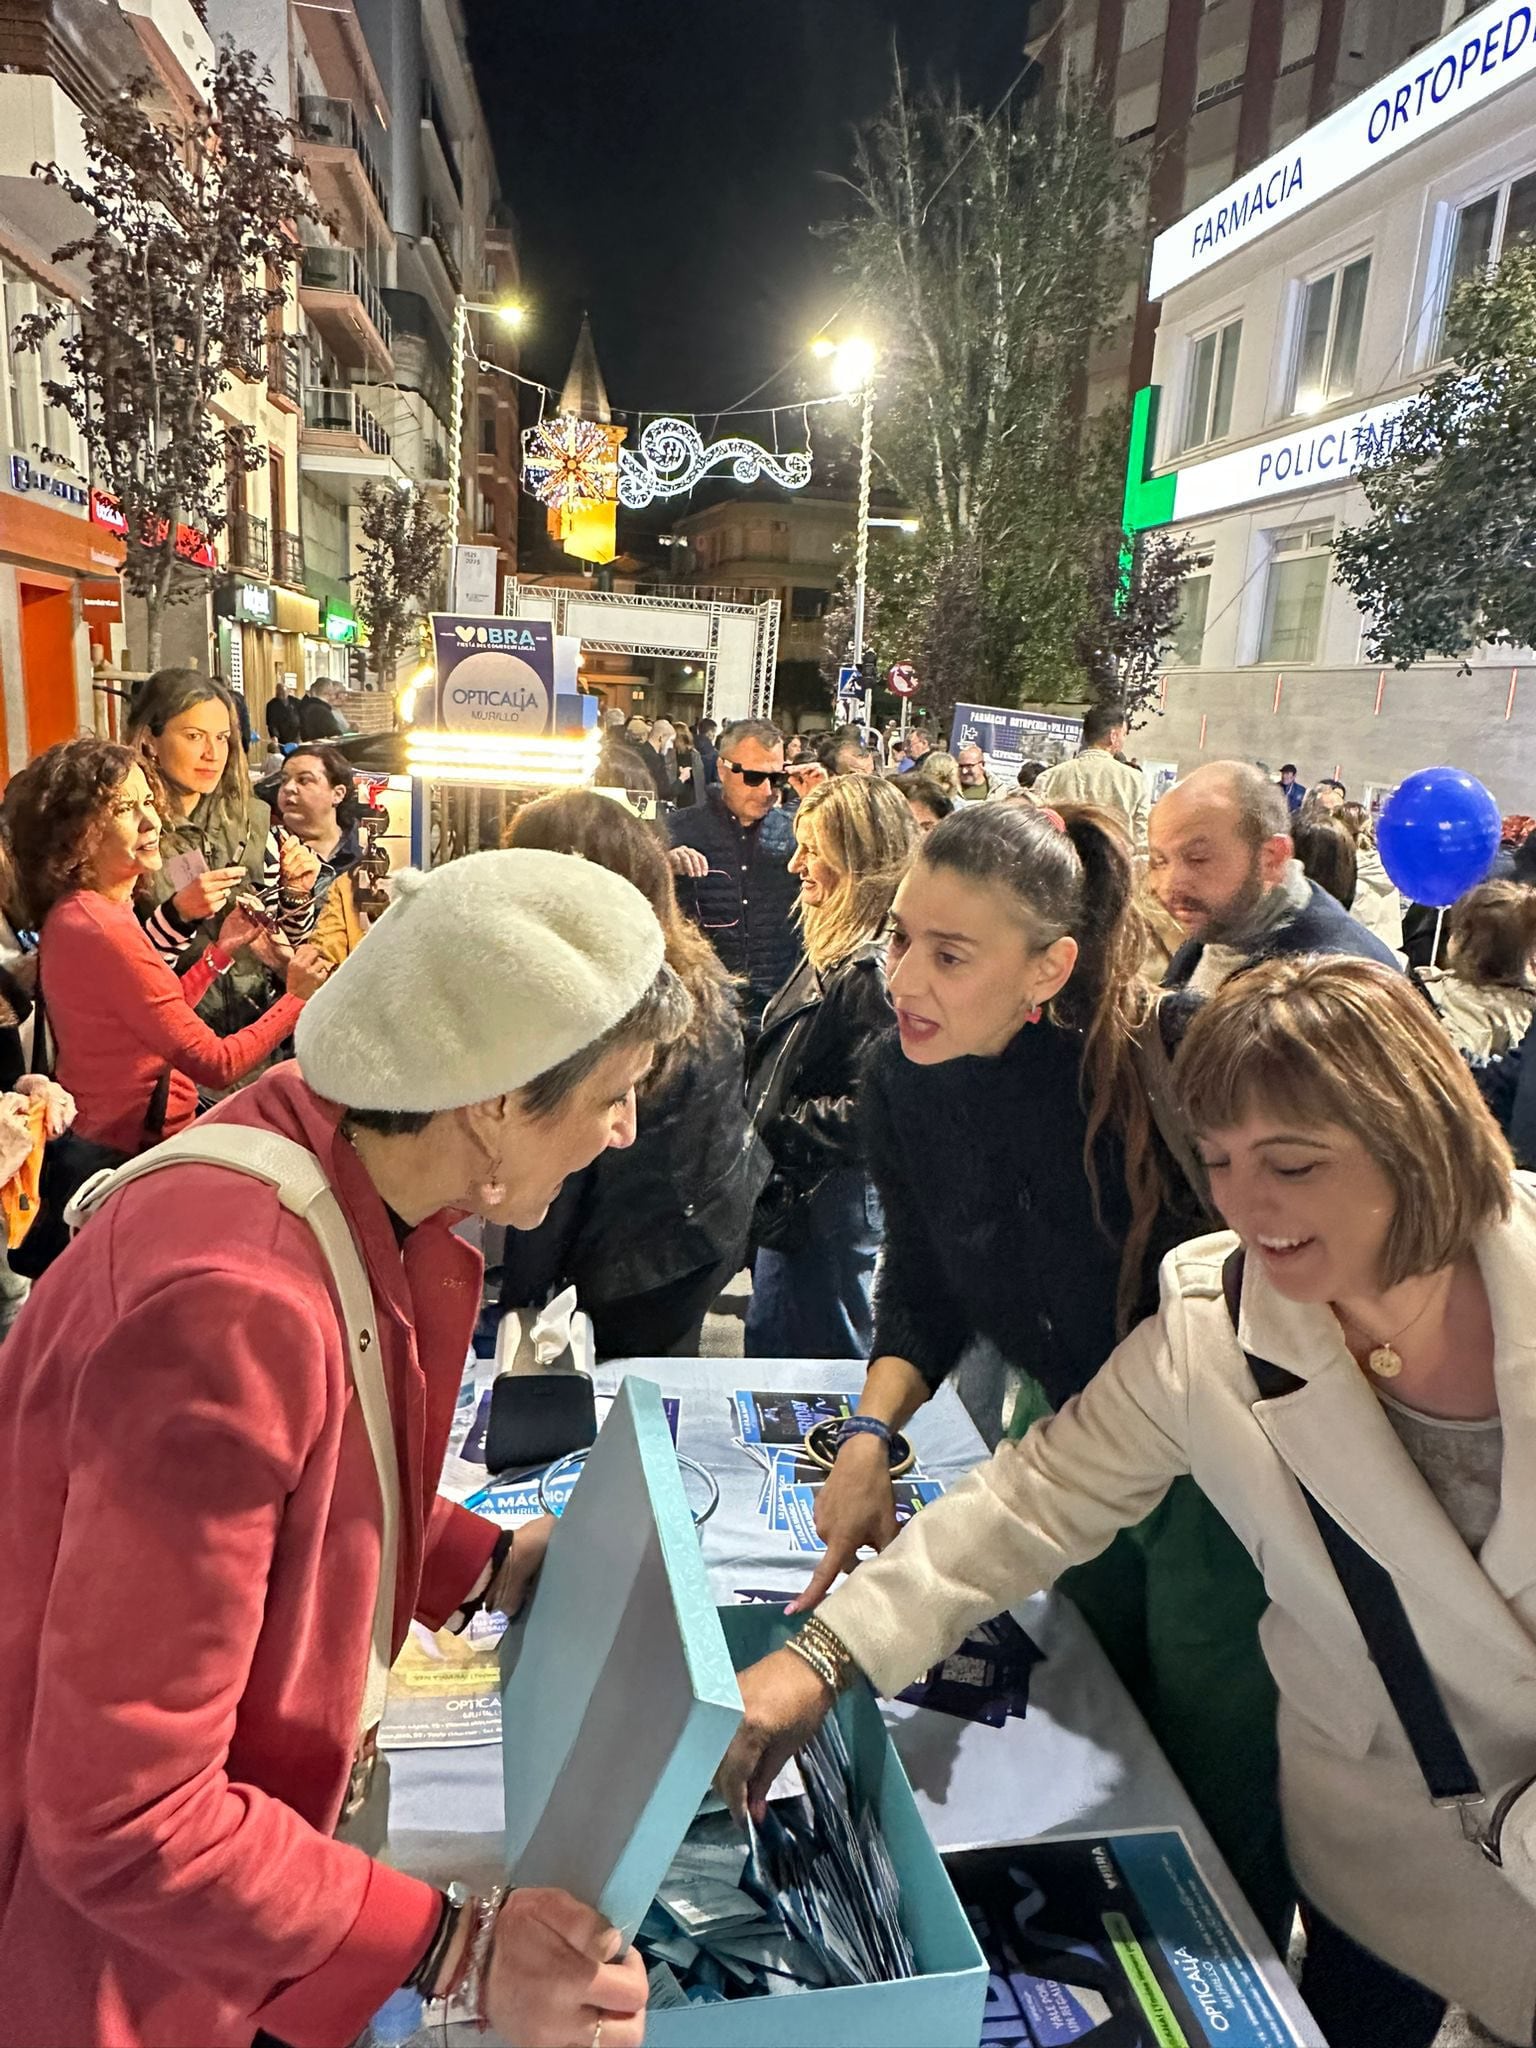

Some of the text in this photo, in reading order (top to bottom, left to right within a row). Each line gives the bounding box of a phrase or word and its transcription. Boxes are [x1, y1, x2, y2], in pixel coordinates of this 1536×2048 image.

[1191, 6, 1536, 259] FARMACIA ORTOPED
[471, 711, 519, 723] MURILLO
[446, 1697, 501, 1711] OPTICA
